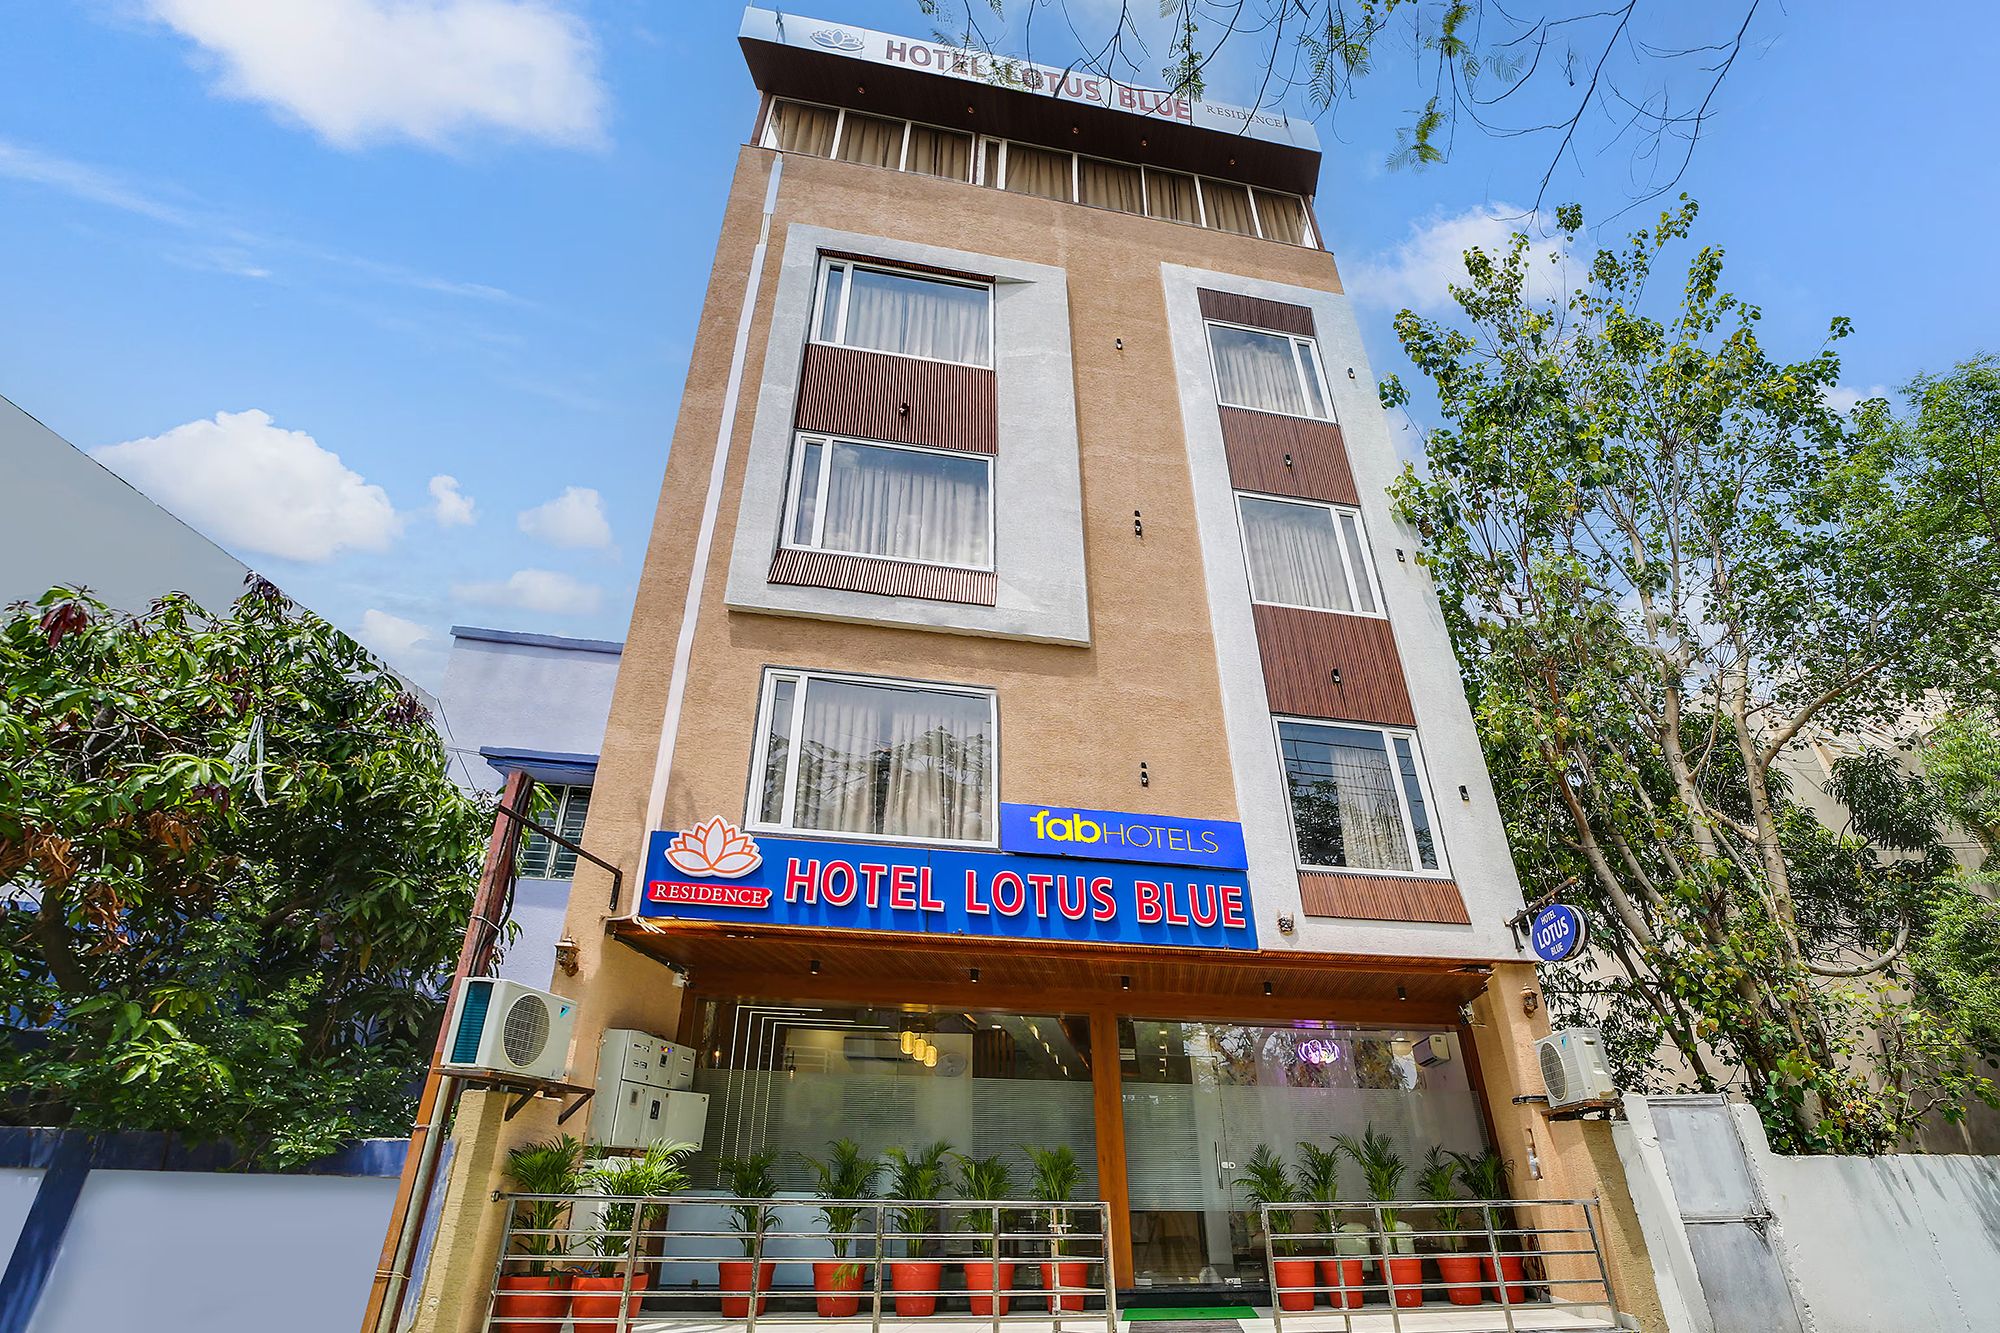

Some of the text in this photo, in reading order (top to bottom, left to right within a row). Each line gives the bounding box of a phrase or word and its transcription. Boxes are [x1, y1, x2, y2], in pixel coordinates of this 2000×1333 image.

[886, 40, 986, 77] HOTEL
[1119, 86, 1191, 121] BLUE
[1206, 104, 1283, 129] RESIDENCE
[654, 883, 764, 904] RESIDENCE
[784, 857, 1246, 929] HOTEL LOTUS BLUE
[1540, 910, 1556, 925] HOTEL
[1537, 916, 1569, 949] LOTUS
[1550, 942, 1564, 956] BLUE
